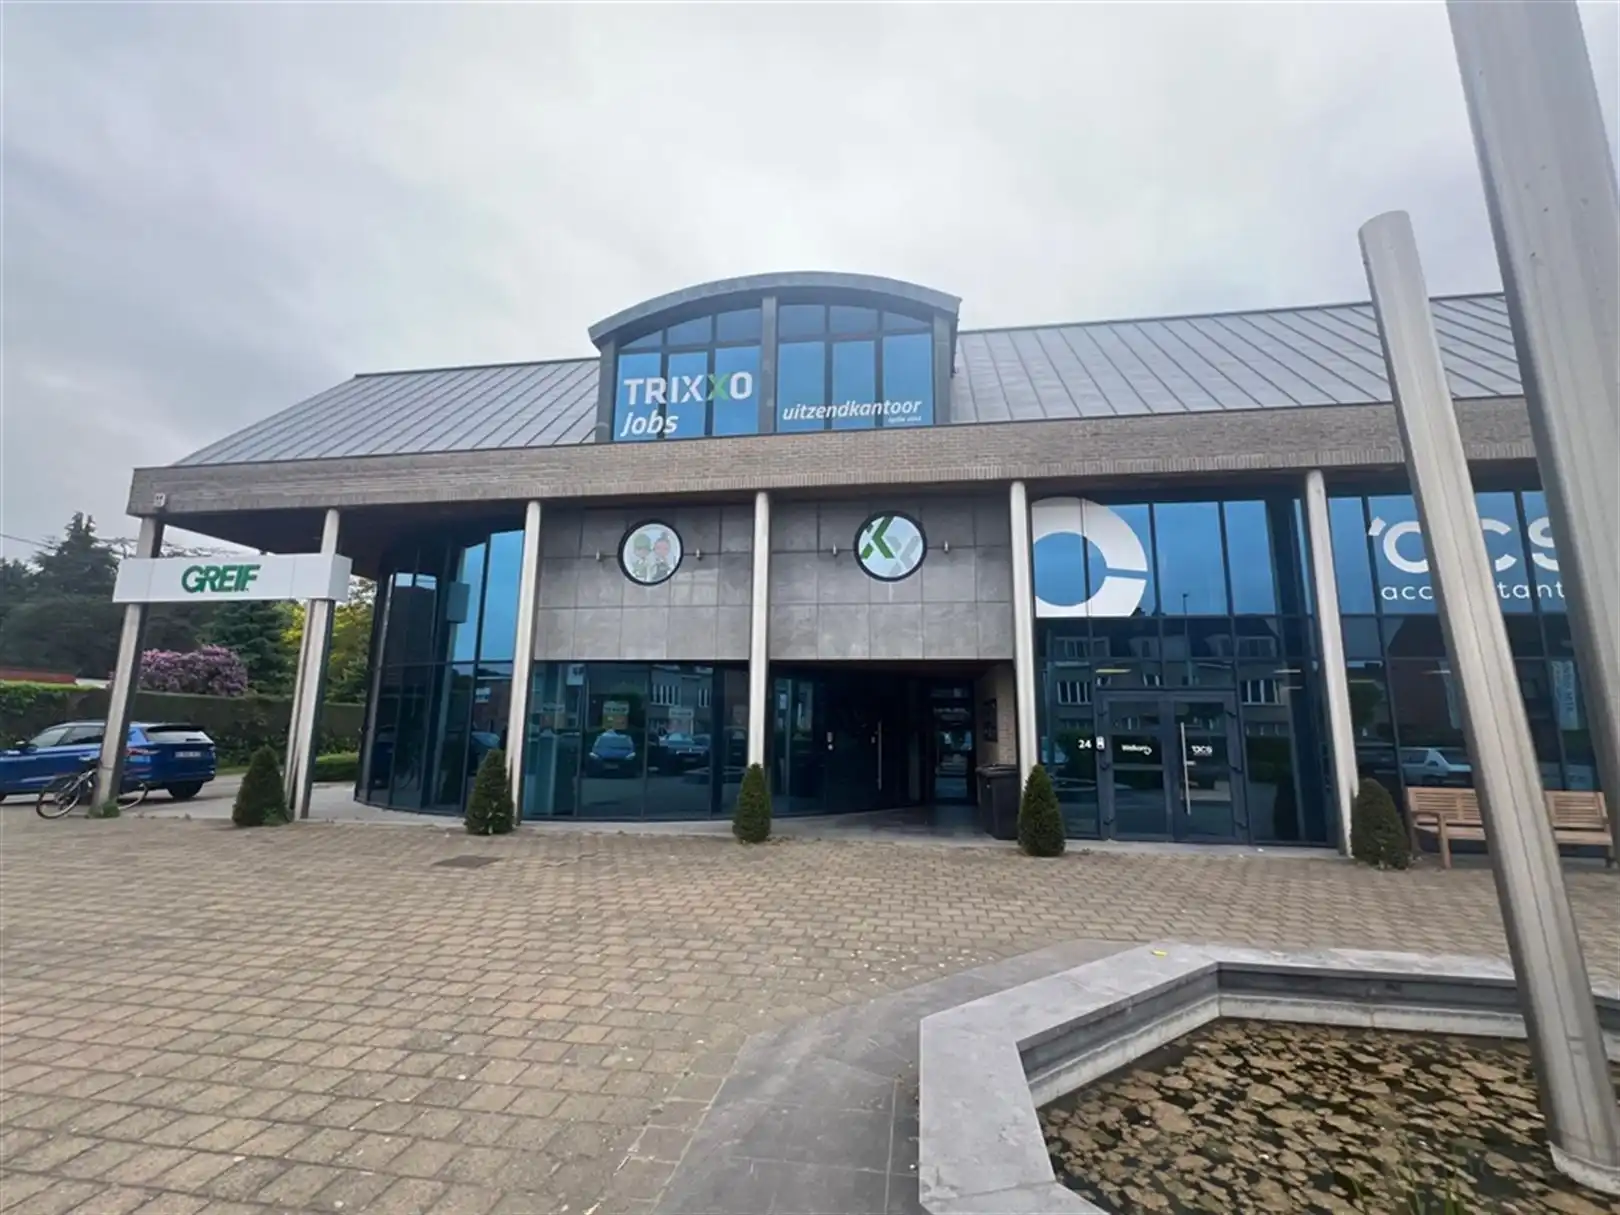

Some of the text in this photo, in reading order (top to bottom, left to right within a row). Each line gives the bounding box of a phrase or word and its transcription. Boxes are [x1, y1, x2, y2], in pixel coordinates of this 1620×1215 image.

[623, 372, 753, 405] TRIXXO
[620, 409, 679, 437] jobs
[782, 400, 922, 420] uitzendkantoor
[181, 565, 261, 593] GREIF
[1078, 739, 1092, 749] 24
